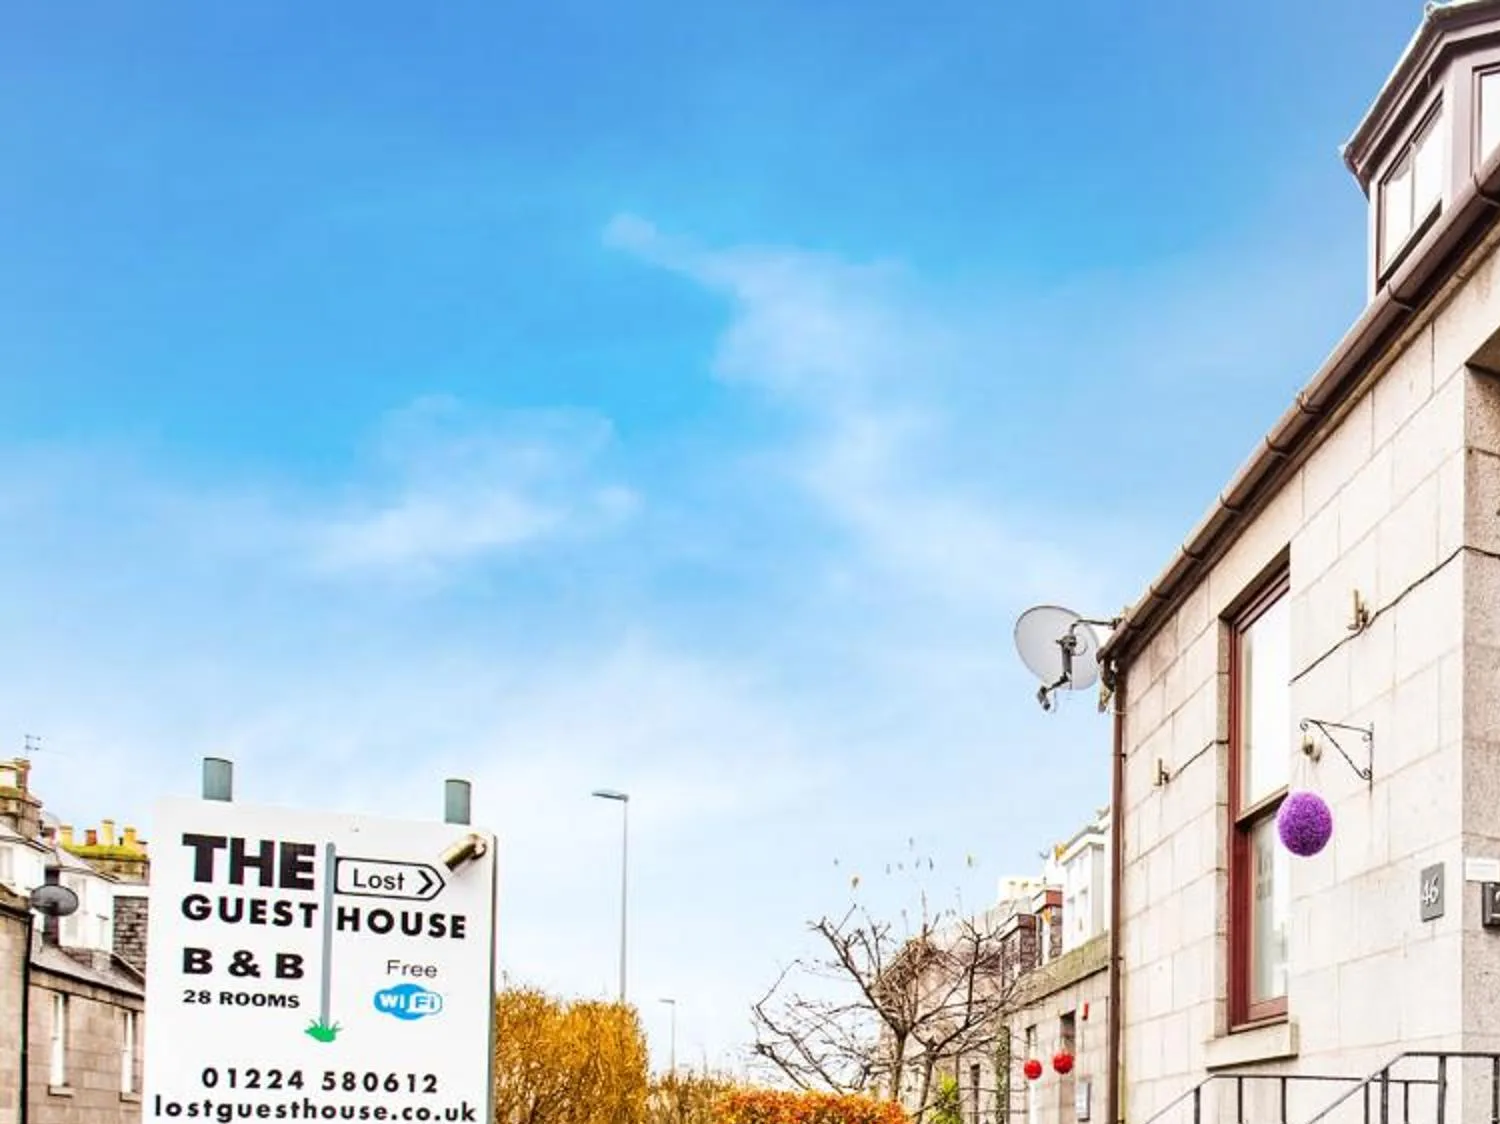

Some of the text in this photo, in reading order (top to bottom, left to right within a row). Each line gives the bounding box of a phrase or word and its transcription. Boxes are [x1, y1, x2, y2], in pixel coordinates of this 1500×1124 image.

[181, 833, 316, 891] THE
[353, 868, 405, 891] Lost
[1423, 875, 1439, 905] 46
[181, 893, 467, 940] GUEST HOUSE
[387, 959, 438, 978] Free
[183, 989, 300, 1009] 28 ROOMS
[201, 1067, 438, 1094] 01224 580612
[155, 1094, 476, 1124] lostguesthouse.co.uk
